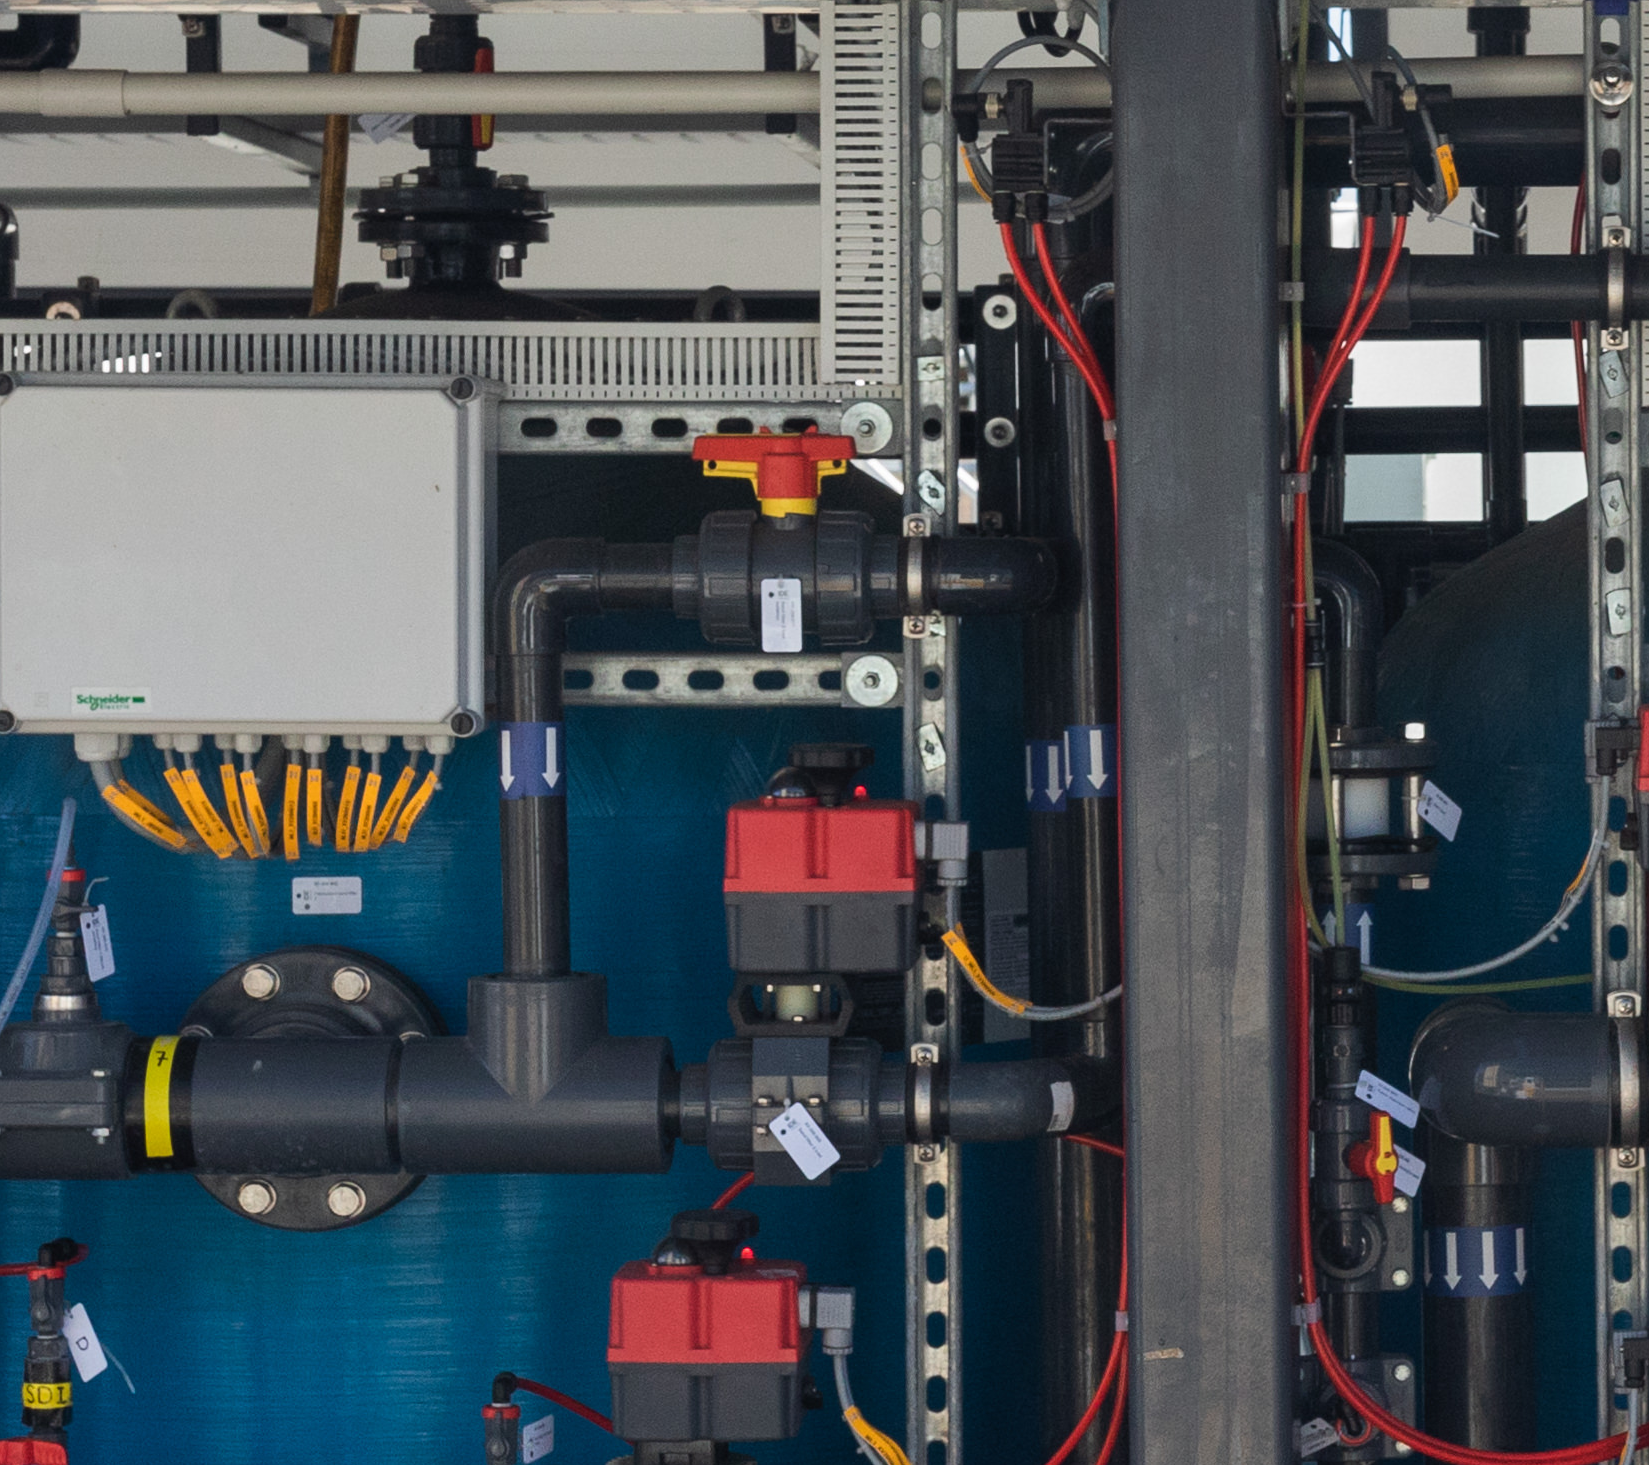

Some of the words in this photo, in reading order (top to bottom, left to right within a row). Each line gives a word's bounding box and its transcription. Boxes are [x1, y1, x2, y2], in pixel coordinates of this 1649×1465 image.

[76, 694, 131, 711] Schneider
[155, 1050, 168, 1067] 7
[26, 1384, 67, 1405] SDI
